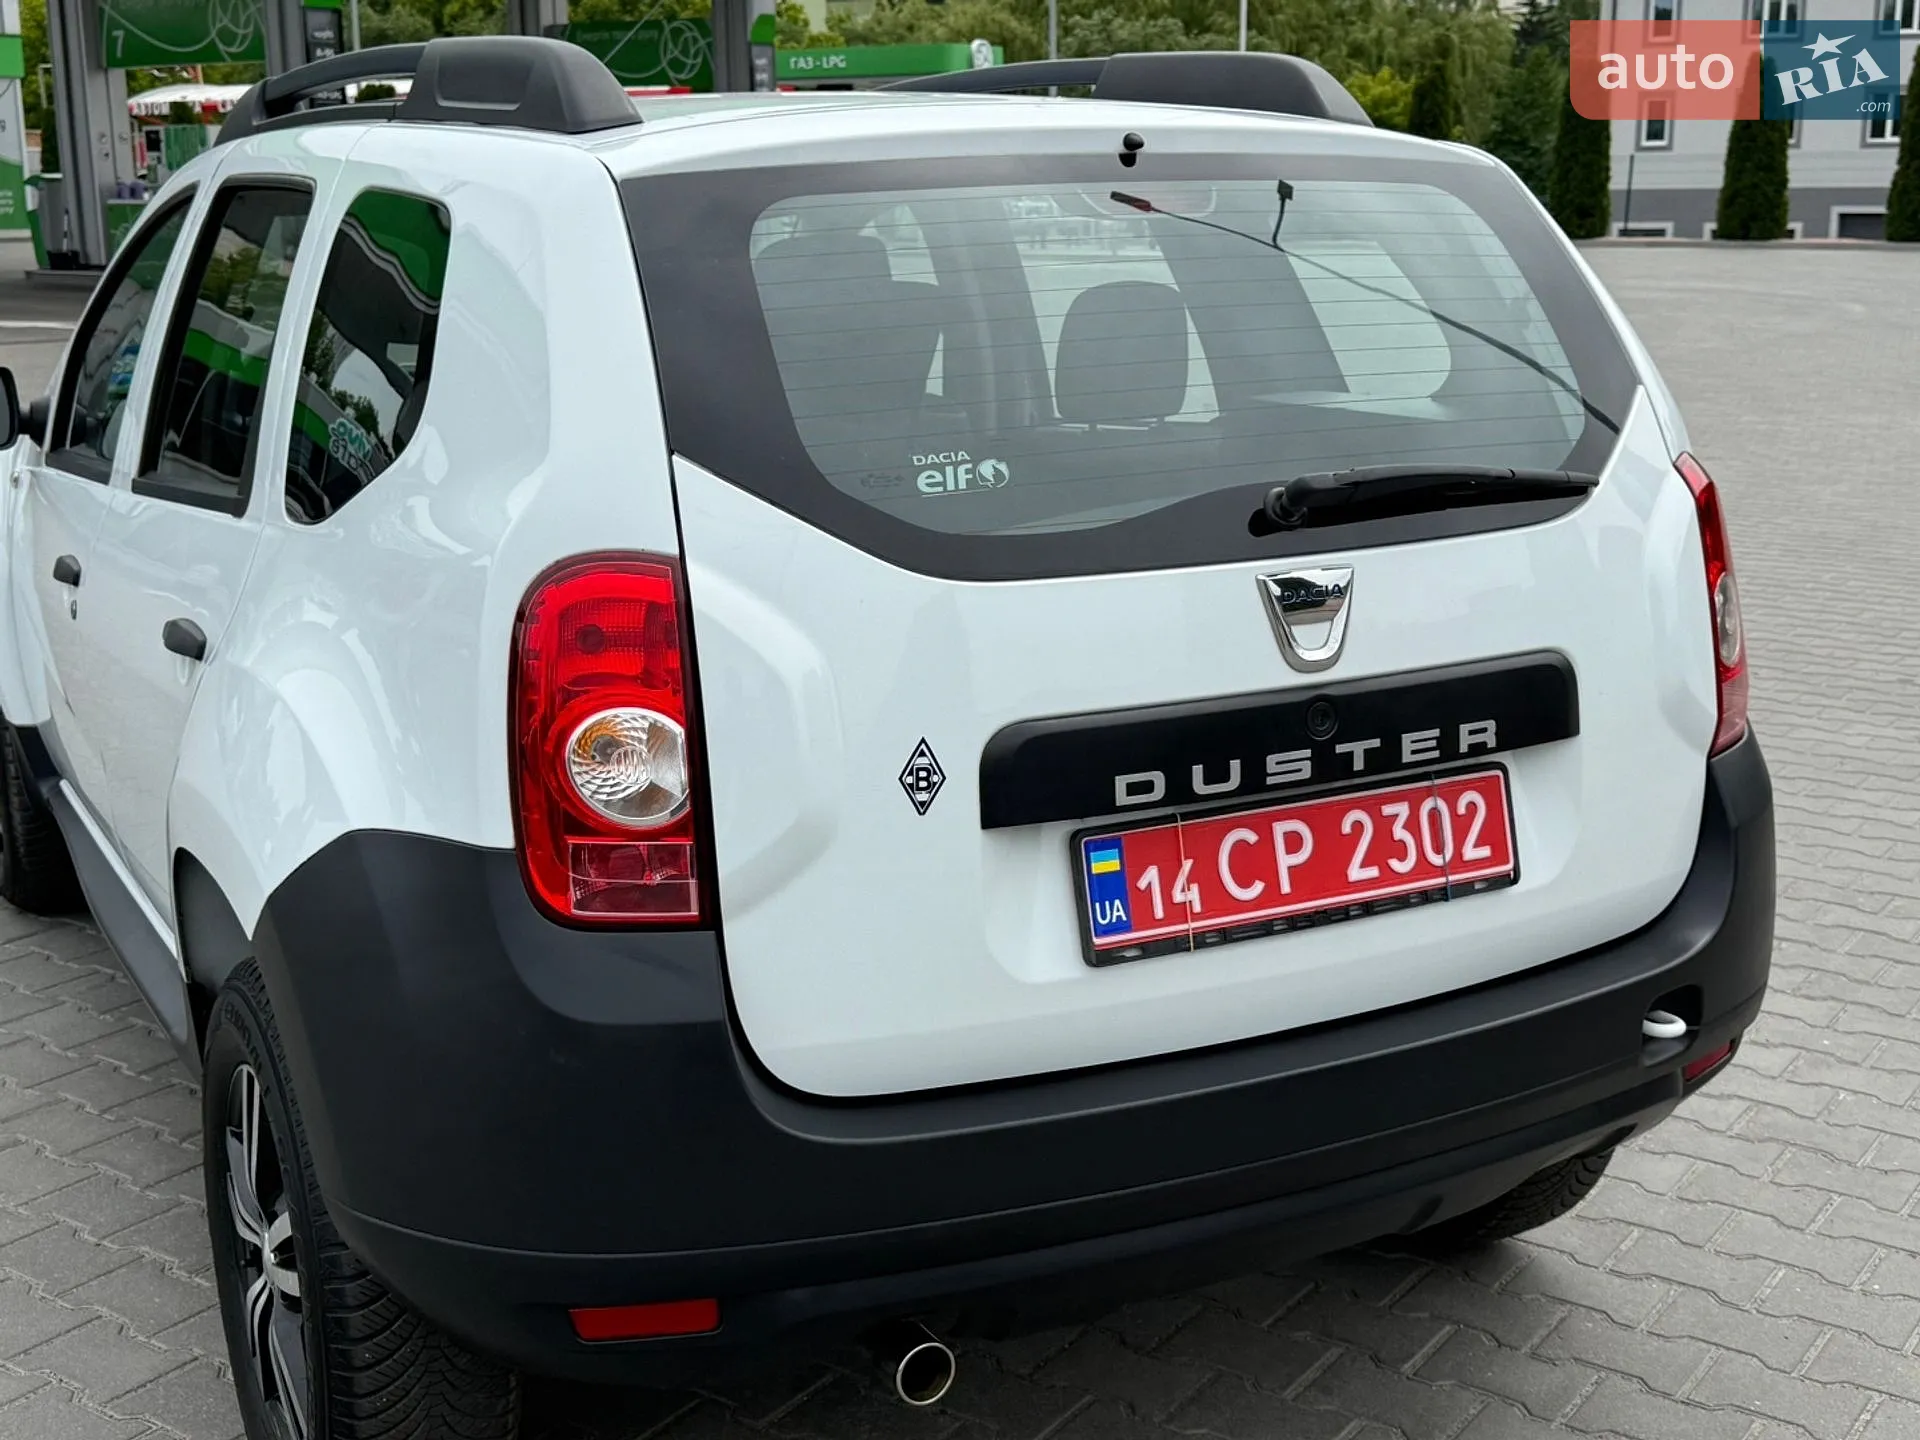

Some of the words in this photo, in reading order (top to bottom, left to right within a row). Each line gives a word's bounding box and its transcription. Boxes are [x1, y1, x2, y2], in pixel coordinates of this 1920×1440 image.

[111, 29, 125, 58] 7
[911, 450, 971, 466] DACIA
[916, 463, 973, 494] elf
[1281, 583, 1344, 604] DACIA
[1114, 719, 1497, 807] DUSTER
[914, 765, 933, 793] B
[1135, 858, 1202, 920] 14
[1340, 789, 1493, 883] 2302
[1095, 900, 1127, 925] UA
